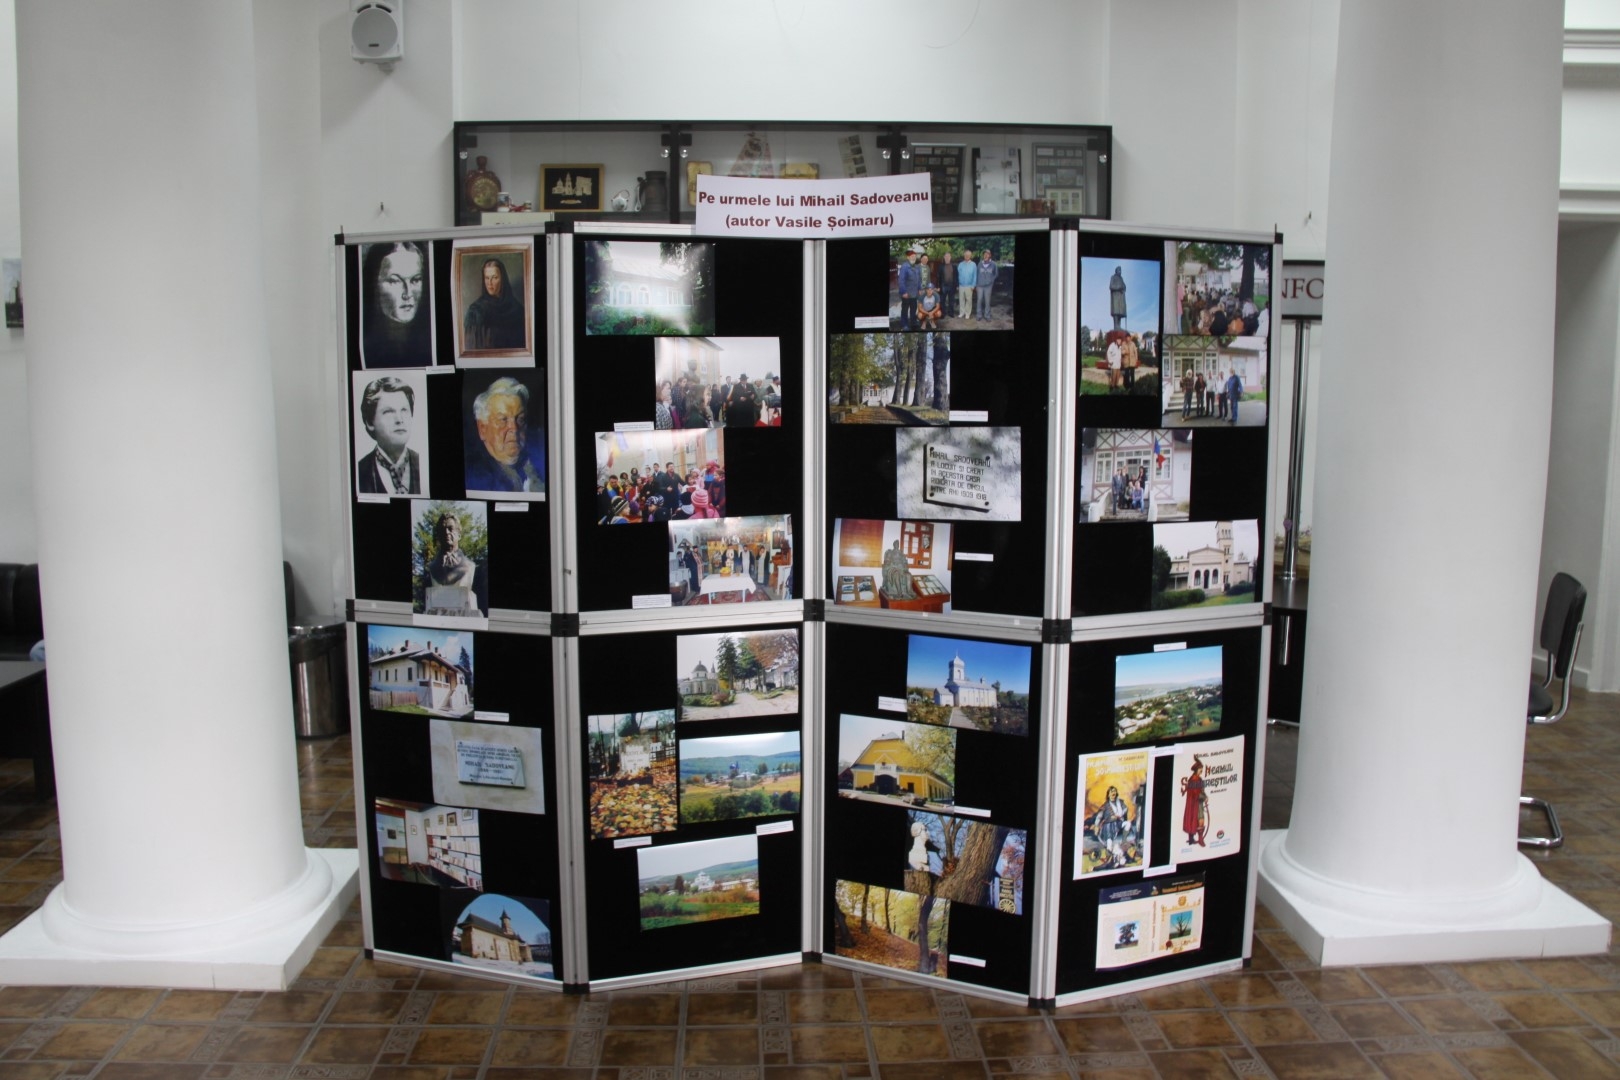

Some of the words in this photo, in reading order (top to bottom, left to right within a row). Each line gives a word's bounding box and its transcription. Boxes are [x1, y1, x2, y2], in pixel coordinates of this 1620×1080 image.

[699, 191, 715, 204] Pe
[720, 193, 771, 206] urmele
[776, 194, 795, 207] lui
[800, 193, 845, 207] Mihail
[850, 191, 929, 205] Sadoveanu
[725, 213, 771, 229] (autor
[776, 215, 822, 228] Vasile
[827, 213, 894, 231] Șoimaru)
